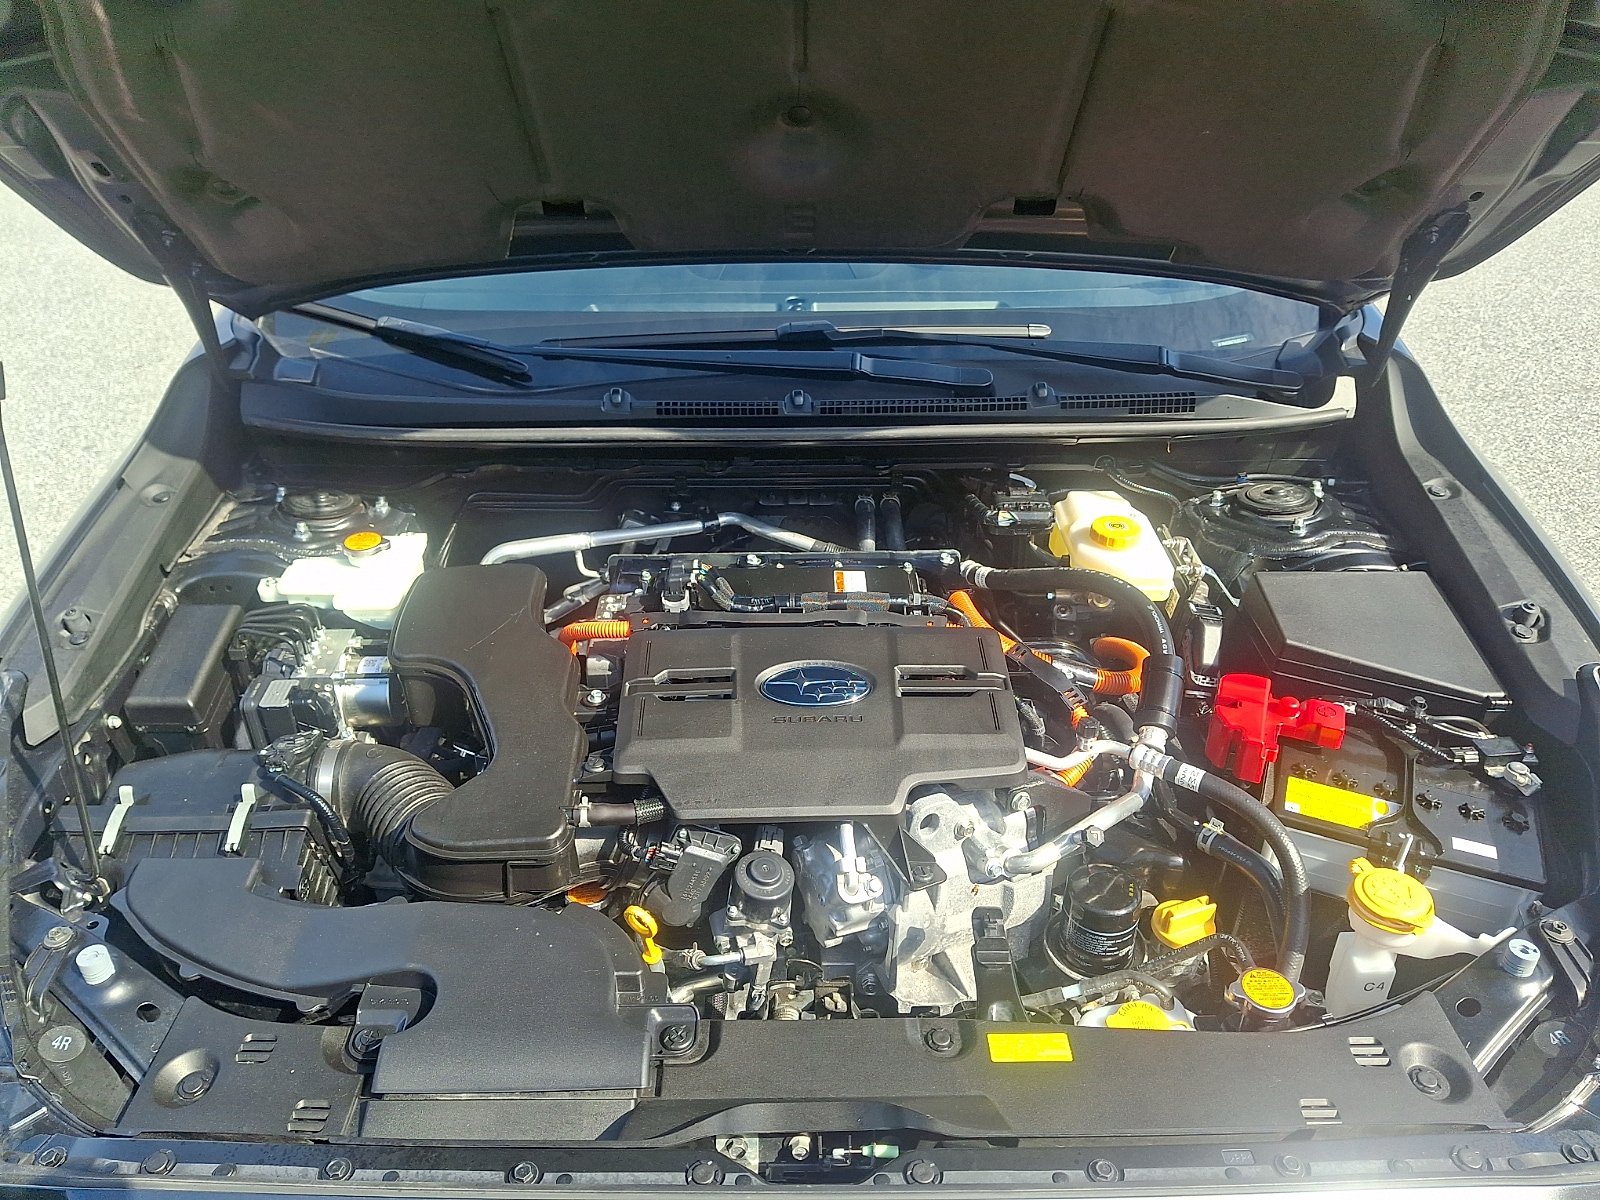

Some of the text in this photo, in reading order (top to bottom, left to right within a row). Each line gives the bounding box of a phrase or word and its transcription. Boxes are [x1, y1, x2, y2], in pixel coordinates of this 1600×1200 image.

[772, 715, 863, 724] SUBARU
[1363, 982, 1385, 992] C4
[51, 1035, 72, 1051] 4R
[1549, 1030, 1571, 1047] 4R
